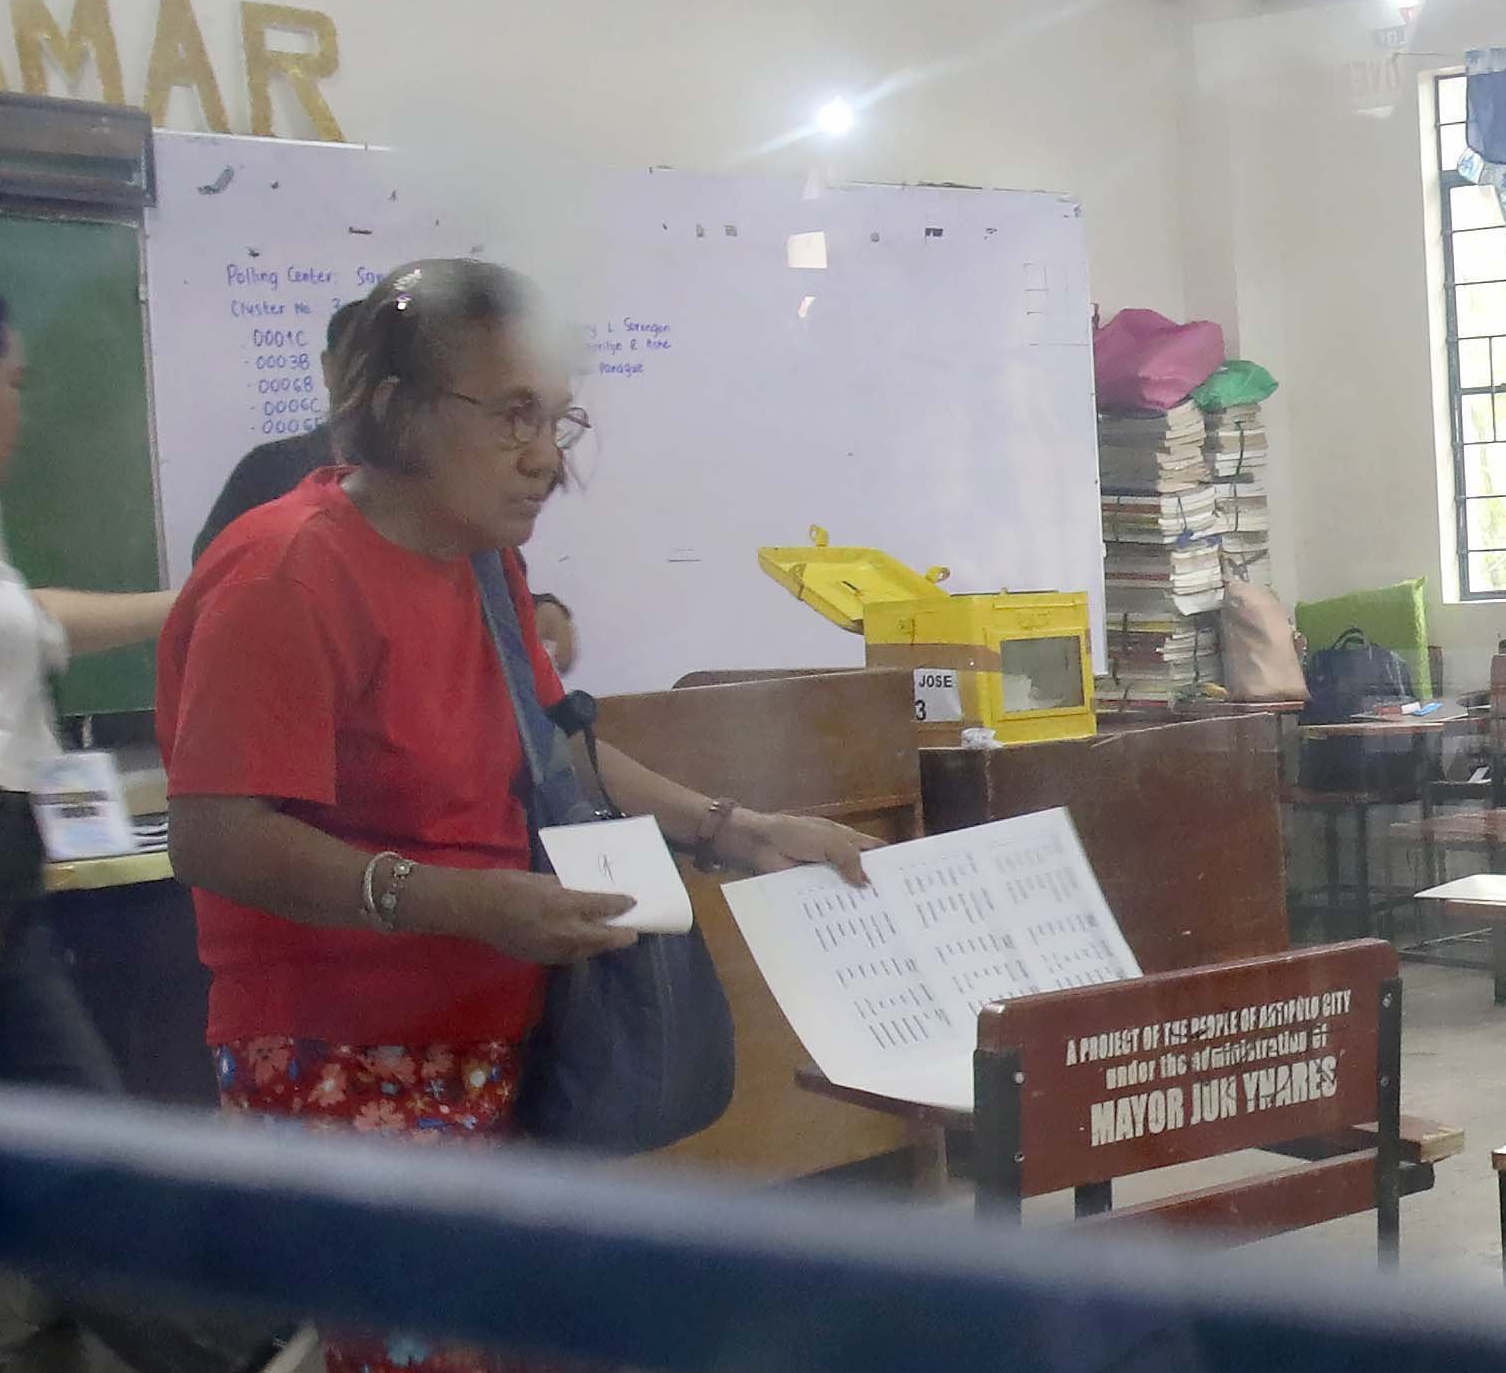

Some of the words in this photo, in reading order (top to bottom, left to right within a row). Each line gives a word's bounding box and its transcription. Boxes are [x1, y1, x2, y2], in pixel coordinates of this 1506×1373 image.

[227, 264, 278, 291] Polling
[231, 299, 285, 317] Cluster
[919, 675, 953, 688] JOSE
[1066, 1039, 1077, 1066] A
[1079, 1028, 1140, 1063] PROJECT
[1143, 1024, 1160, 1051] OF
[1163, 1019, 1188, 1047] THE
[1190, 1010, 1239, 1041] PEOPLE
[1240, 1006, 1257, 1033] OF
[1322, 989, 1352, 1018] CITY
[1106, 1059, 1156, 1090] under
[1160, 1053, 1187, 1078] the
[1191, 1031, 1307, 1072] administration
[1312, 1023, 1328, 1049] of
[1091, 1087, 1184, 1147] MAYOR
[1190, 1075, 1237, 1125] JUN
[1243, 1055, 1337, 1114] YNARES
